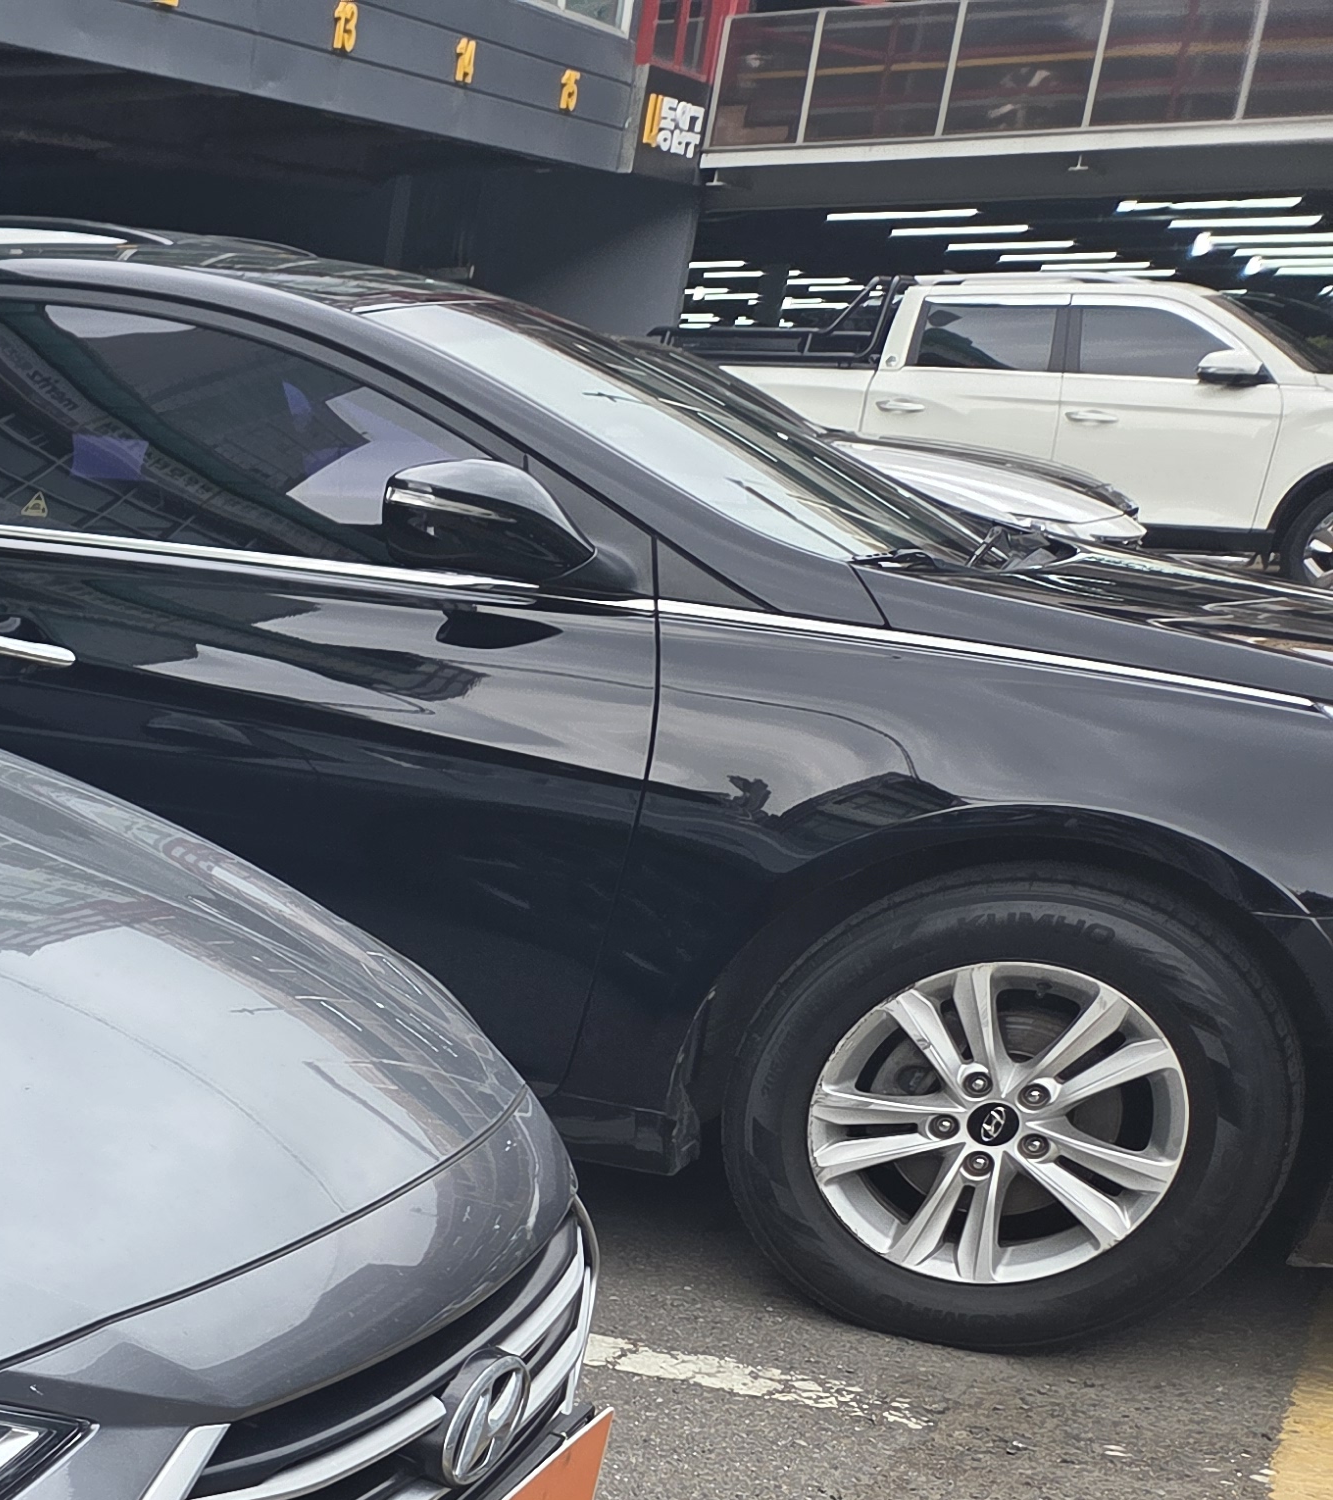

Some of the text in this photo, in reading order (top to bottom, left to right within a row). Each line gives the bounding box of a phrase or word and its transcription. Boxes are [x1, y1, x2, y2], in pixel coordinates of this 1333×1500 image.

[333, 2, 358, 52] 13
[455, 37, 476, 84] 14
[560, 69, 580, 111] 15
[955, 911, 1116, 945] KUMHO
